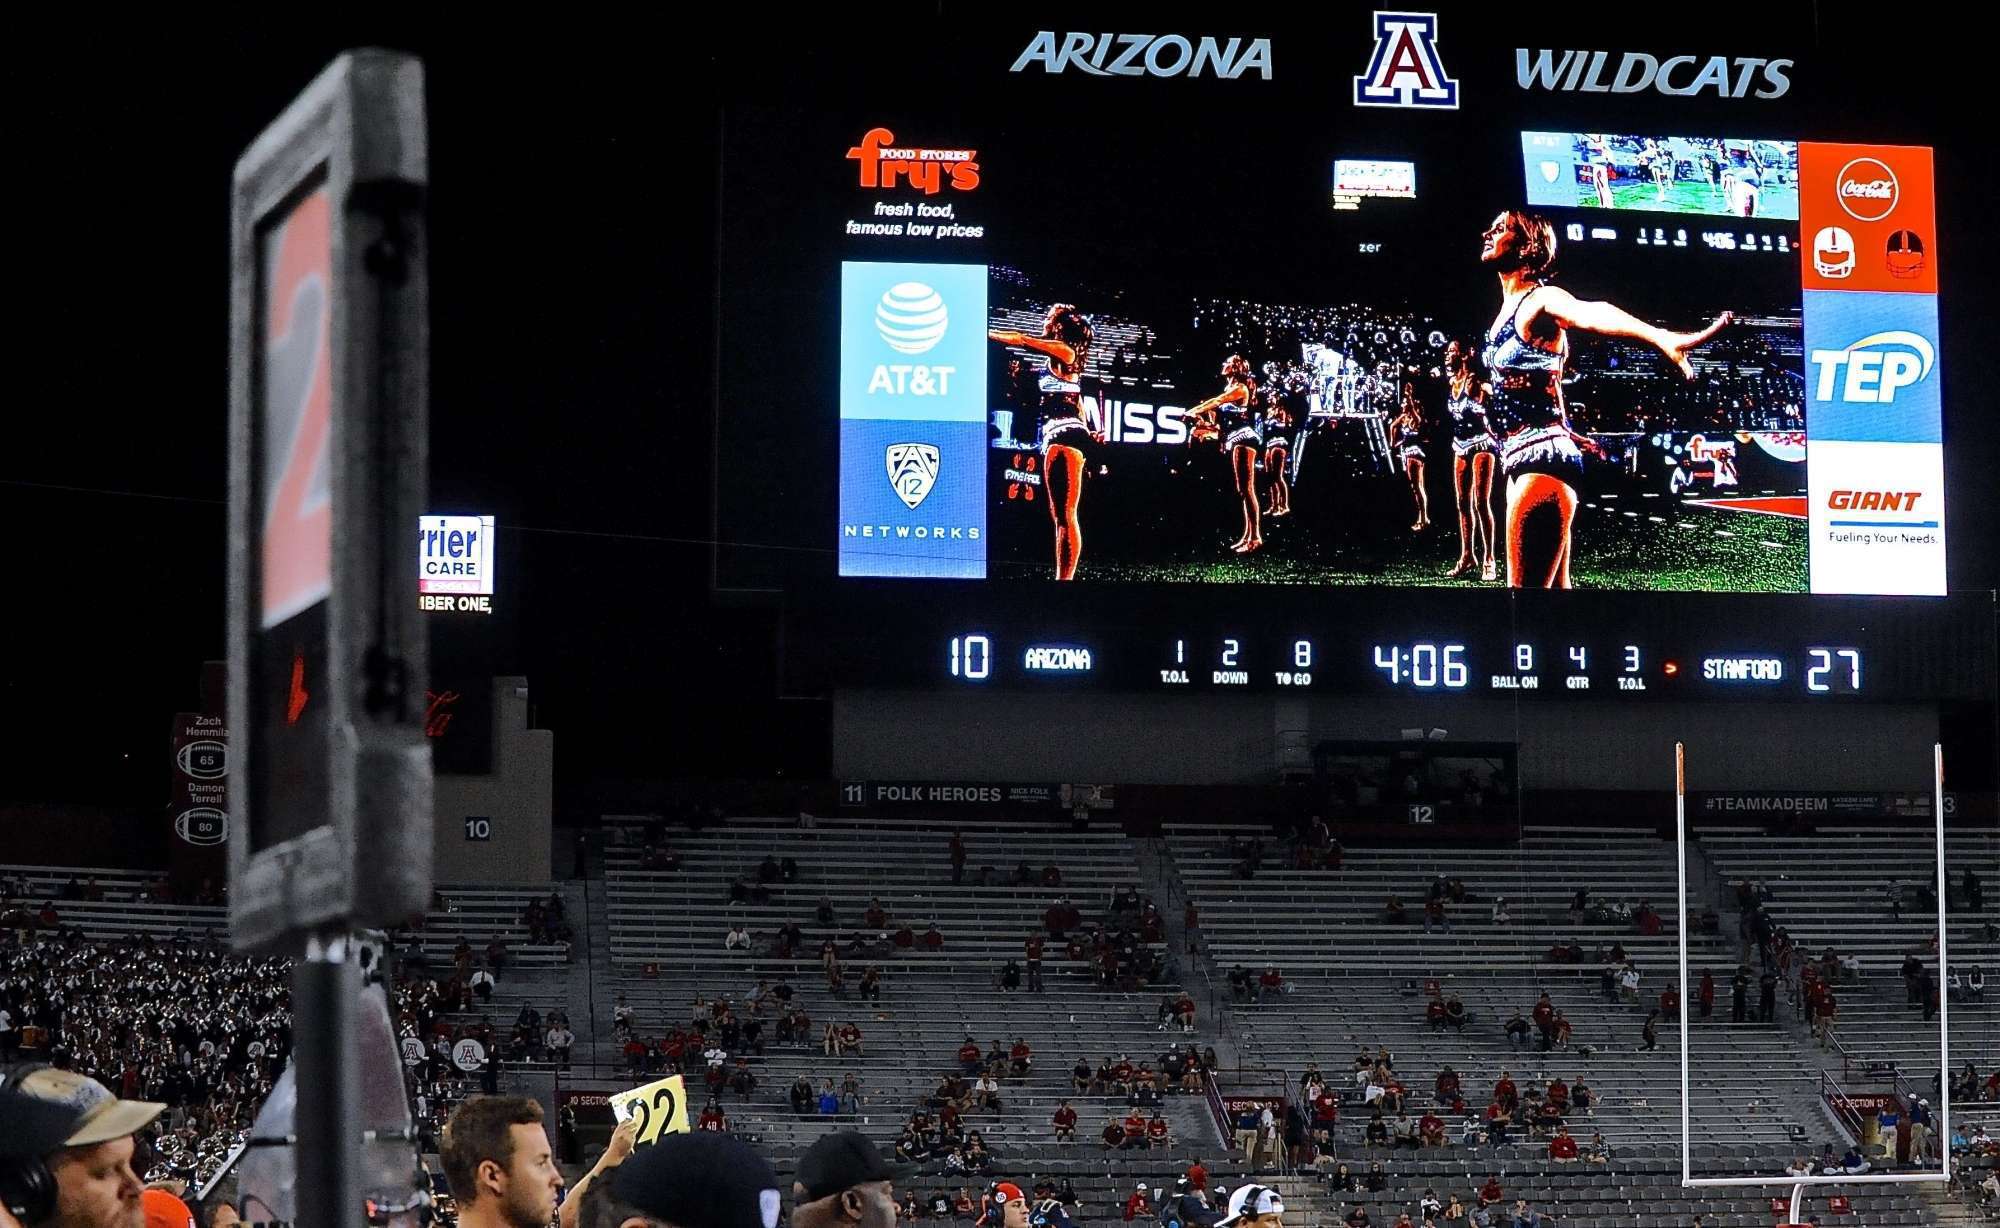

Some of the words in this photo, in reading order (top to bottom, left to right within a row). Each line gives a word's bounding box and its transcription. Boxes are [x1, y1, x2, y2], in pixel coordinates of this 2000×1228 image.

[1010, 31, 1272, 79] ARIZONA
[1354, 11, 1459, 109] A
[1516, 48, 1794, 98] WILDCATS
[846, 128, 980, 195] fry's
[880, 149, 915, 159] FOOD
[920, 150, 969, 160] STORES
[874, 202, 913, 216] fresh
[916, 203, 955, 219] food,
[846, 220, 902, 235] famous
[906, 222, 934, 236] low
[936, 223, 984, 239] prices
[1360, 244, 1381, 252] zer
[868, 365, 955, 396] AT&T
[1811, 350, 1922, 403] TEP
[904, 479, 922, 495] 12
[1829, 491, 1921, 511] GIANT
[420, 520, 477, 558] rier
[844, 525, 980, 539] NETWORKS
[1830, 532, 1870, 544] Fueling
[1874, 533, 1898, 542] Your
[1901, 534, 1938, 544] Needs.
[427, 562, 475, 575] CARE
[420, 596, 455, 610] BER
[458, 597, 491, 613] ONE,
[951, 635, 989, 679] 10
[1025, 647, 1091, 670] ARIZONA
[1177, 640, 1184, 663] 1
[1223, 640, 1239, 665] 2
[1295, 641, 1311, 667] 8
[1515, 645, 1532, 670] 8
[1570, 647, 1585, 669] 4
[1625, 646, 1639, 671] 3
[1374, 644, 1467, 687] 4:06
[1703, 657, 1782, 681] STANFORD
[1807, 648, 1860, 692] 27
[1214, 671, 1248, 684] DOWN
[1276, 672, 1291, 685] TO
[1294, 672, 1311, 685] GO
[1492, 676, 1520, 688] BALL
[1523, 676, 1538, 688] ON
[1566, 676, 1589, 688] QTR
[195, 716, 222, 726] Zach
[200, 755, 214, 766] 65
[188, 782, 225, 793] Damon
[845, 785, 862, 802] 11
[877, 786, 922, 801] FOLK
[929, 787, 1001, 802] HEROES
[190, 793, 222, 804] Terrell
[1705, 798, 1828, 811] #TEAMKADEEM
[1411, 806, 1433, 823] 12
[466, 820, 490, 838] 10
[627, 1088, 679, 1150] 22
